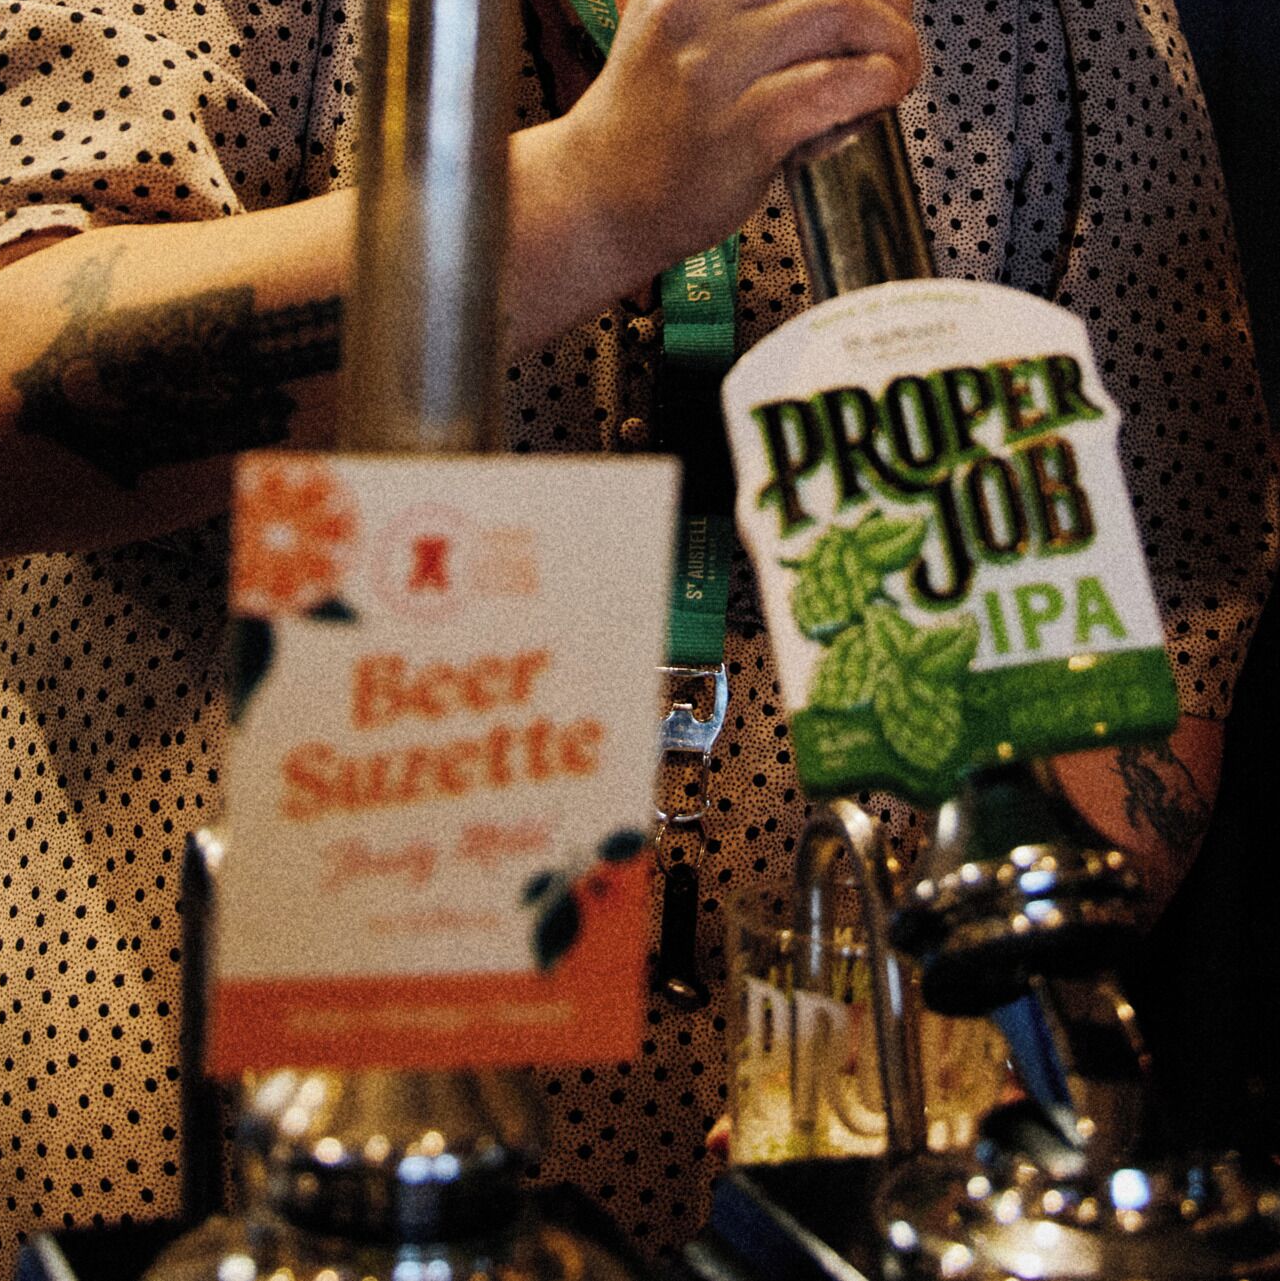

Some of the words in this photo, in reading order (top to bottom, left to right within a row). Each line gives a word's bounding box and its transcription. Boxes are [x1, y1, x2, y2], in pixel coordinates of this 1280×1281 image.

[750, 354, 1104, 540] PROPER
[687, 517, 707, 579] AUSTELL
[907, 436, 1097, 610] JOB
[982, 576, 1127, 655] IPA
[351, 650, 550, 731] Beer
